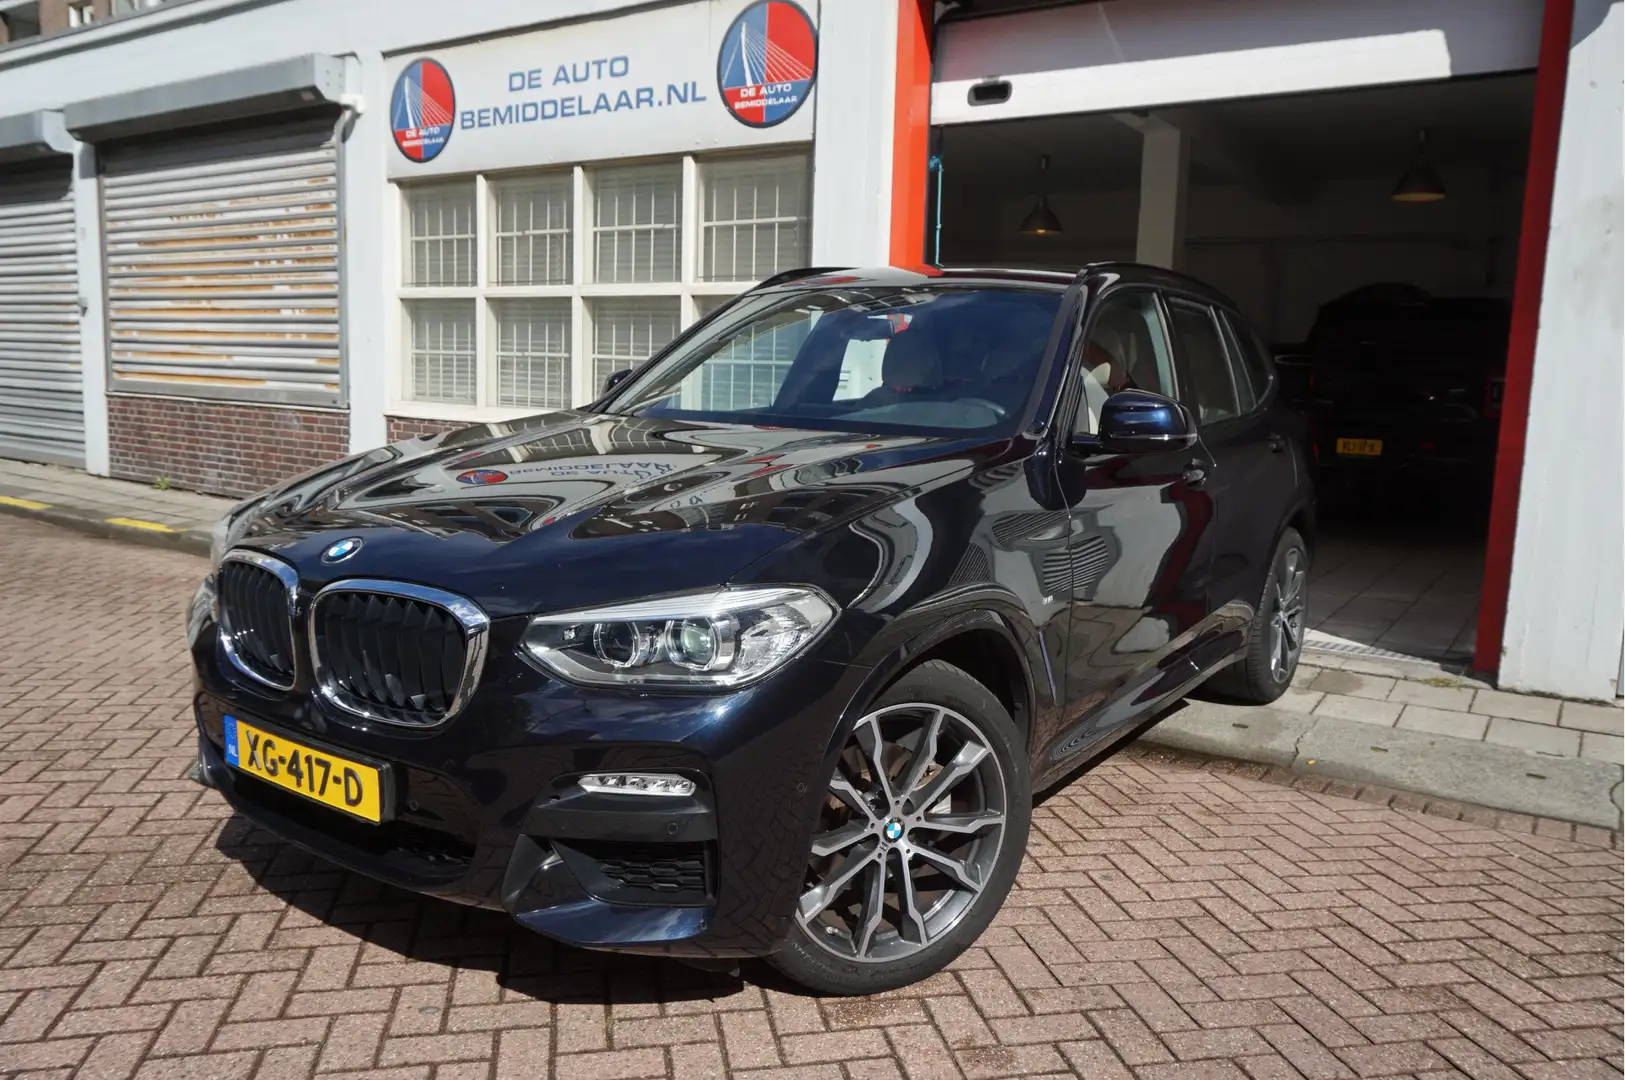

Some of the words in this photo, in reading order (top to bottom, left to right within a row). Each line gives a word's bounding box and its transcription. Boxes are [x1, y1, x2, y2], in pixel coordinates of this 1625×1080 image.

[508, 68, 543, 93] DE
[552, 55, 629, 87] AUTO
[740, 87, 756, 98] DE
[759, 83, 792, 96] AUTO
[460, 81, 707, 130] BEMIDDELAAR.NL
[734, 95, 798, 109] BEMIDDELAAR
[246, 730, 363, 807] XG-417-D
